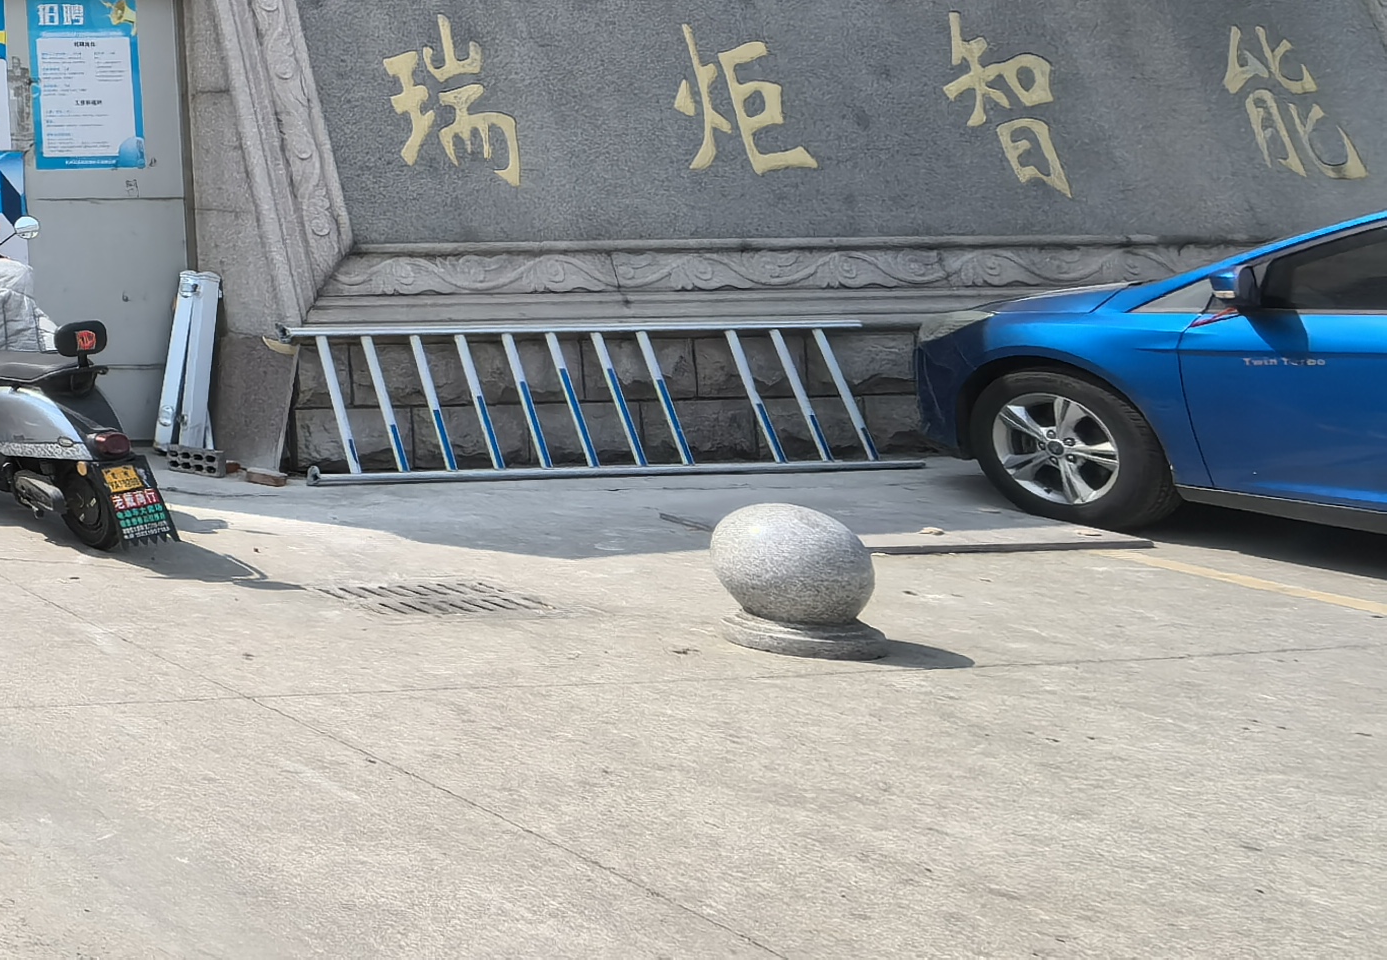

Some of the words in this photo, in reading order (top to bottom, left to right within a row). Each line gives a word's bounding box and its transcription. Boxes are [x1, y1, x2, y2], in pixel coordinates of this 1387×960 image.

[37, 3, 84, 26] 招聘
[381, 10, 1368, 199] 瑞炬智能
[1244, 357, 1277, 366] Twin
